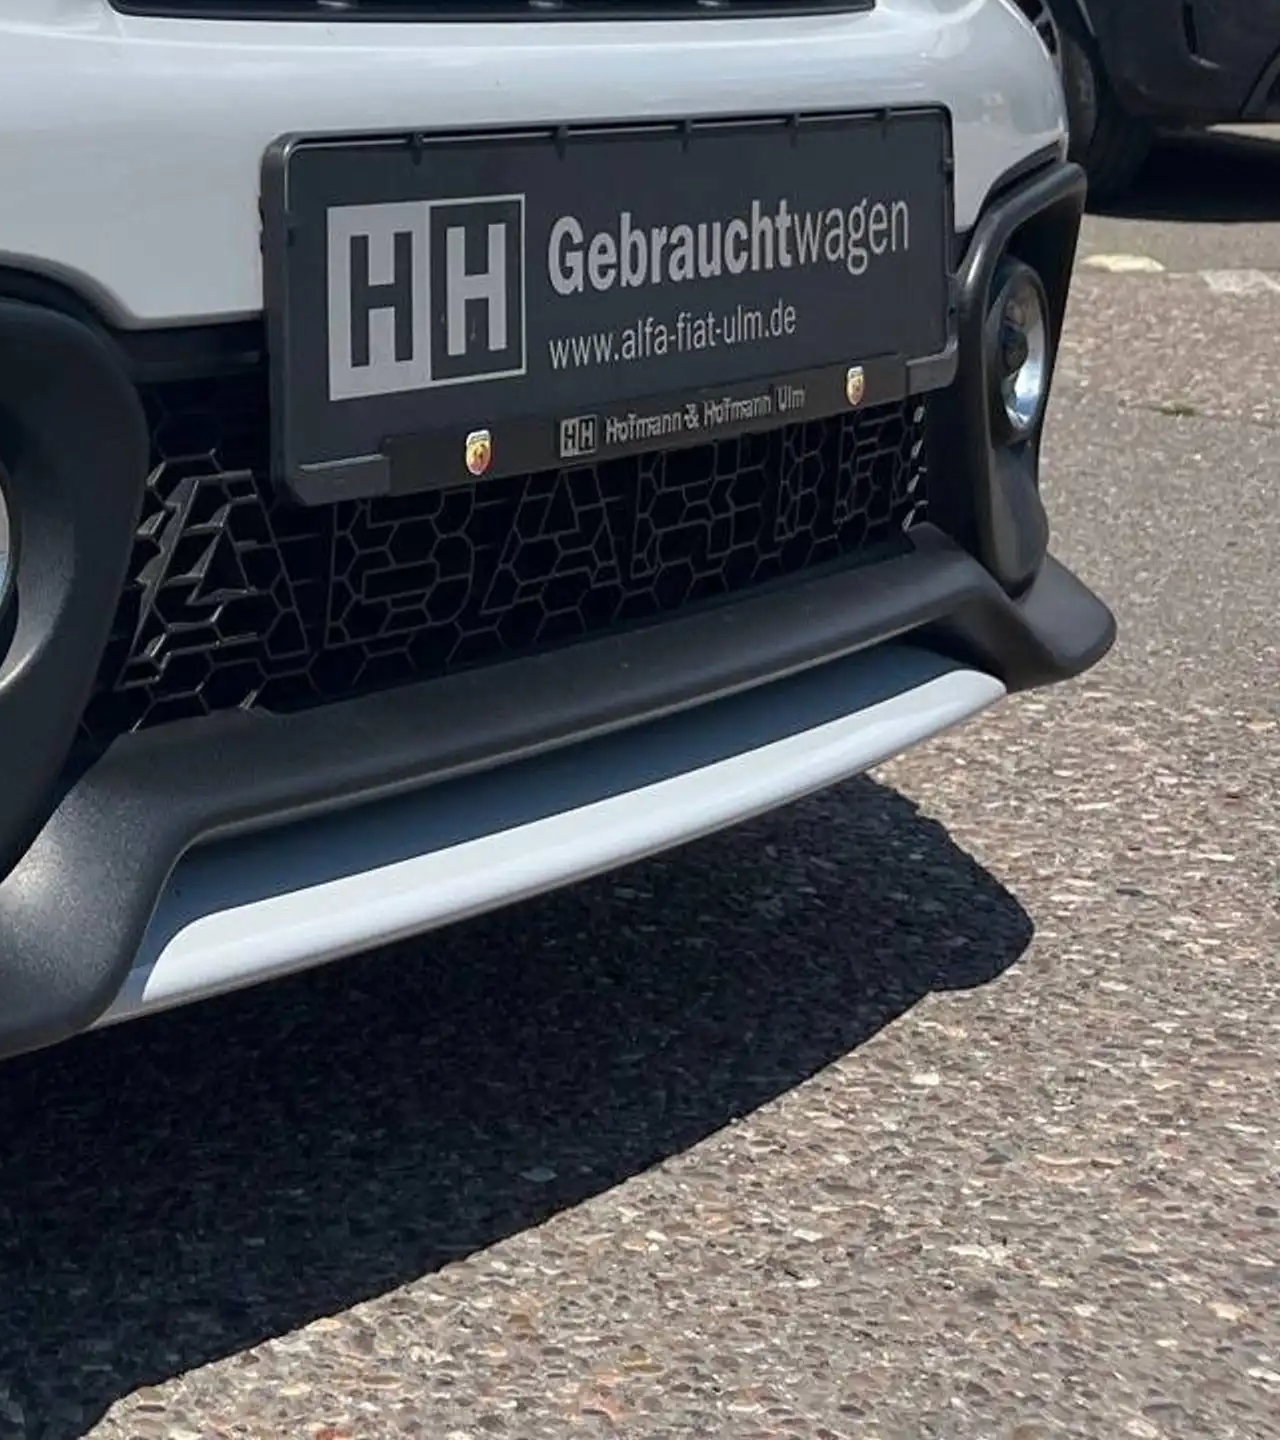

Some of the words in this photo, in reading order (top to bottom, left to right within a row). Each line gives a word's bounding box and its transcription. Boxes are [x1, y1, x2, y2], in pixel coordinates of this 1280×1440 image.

[547, 197, 907, 295] Gebrauchtwagen
[348, 222, 508, 370] HH
[548, 298, 797, 370] www.alfa-fiat-ulm.de
[605, 412, 682, 445] Hofmann
[683, 404, 700, 430] &
[703, 396, 773, 426] Hofmann
[775, 385, 807, 412] Ulm
